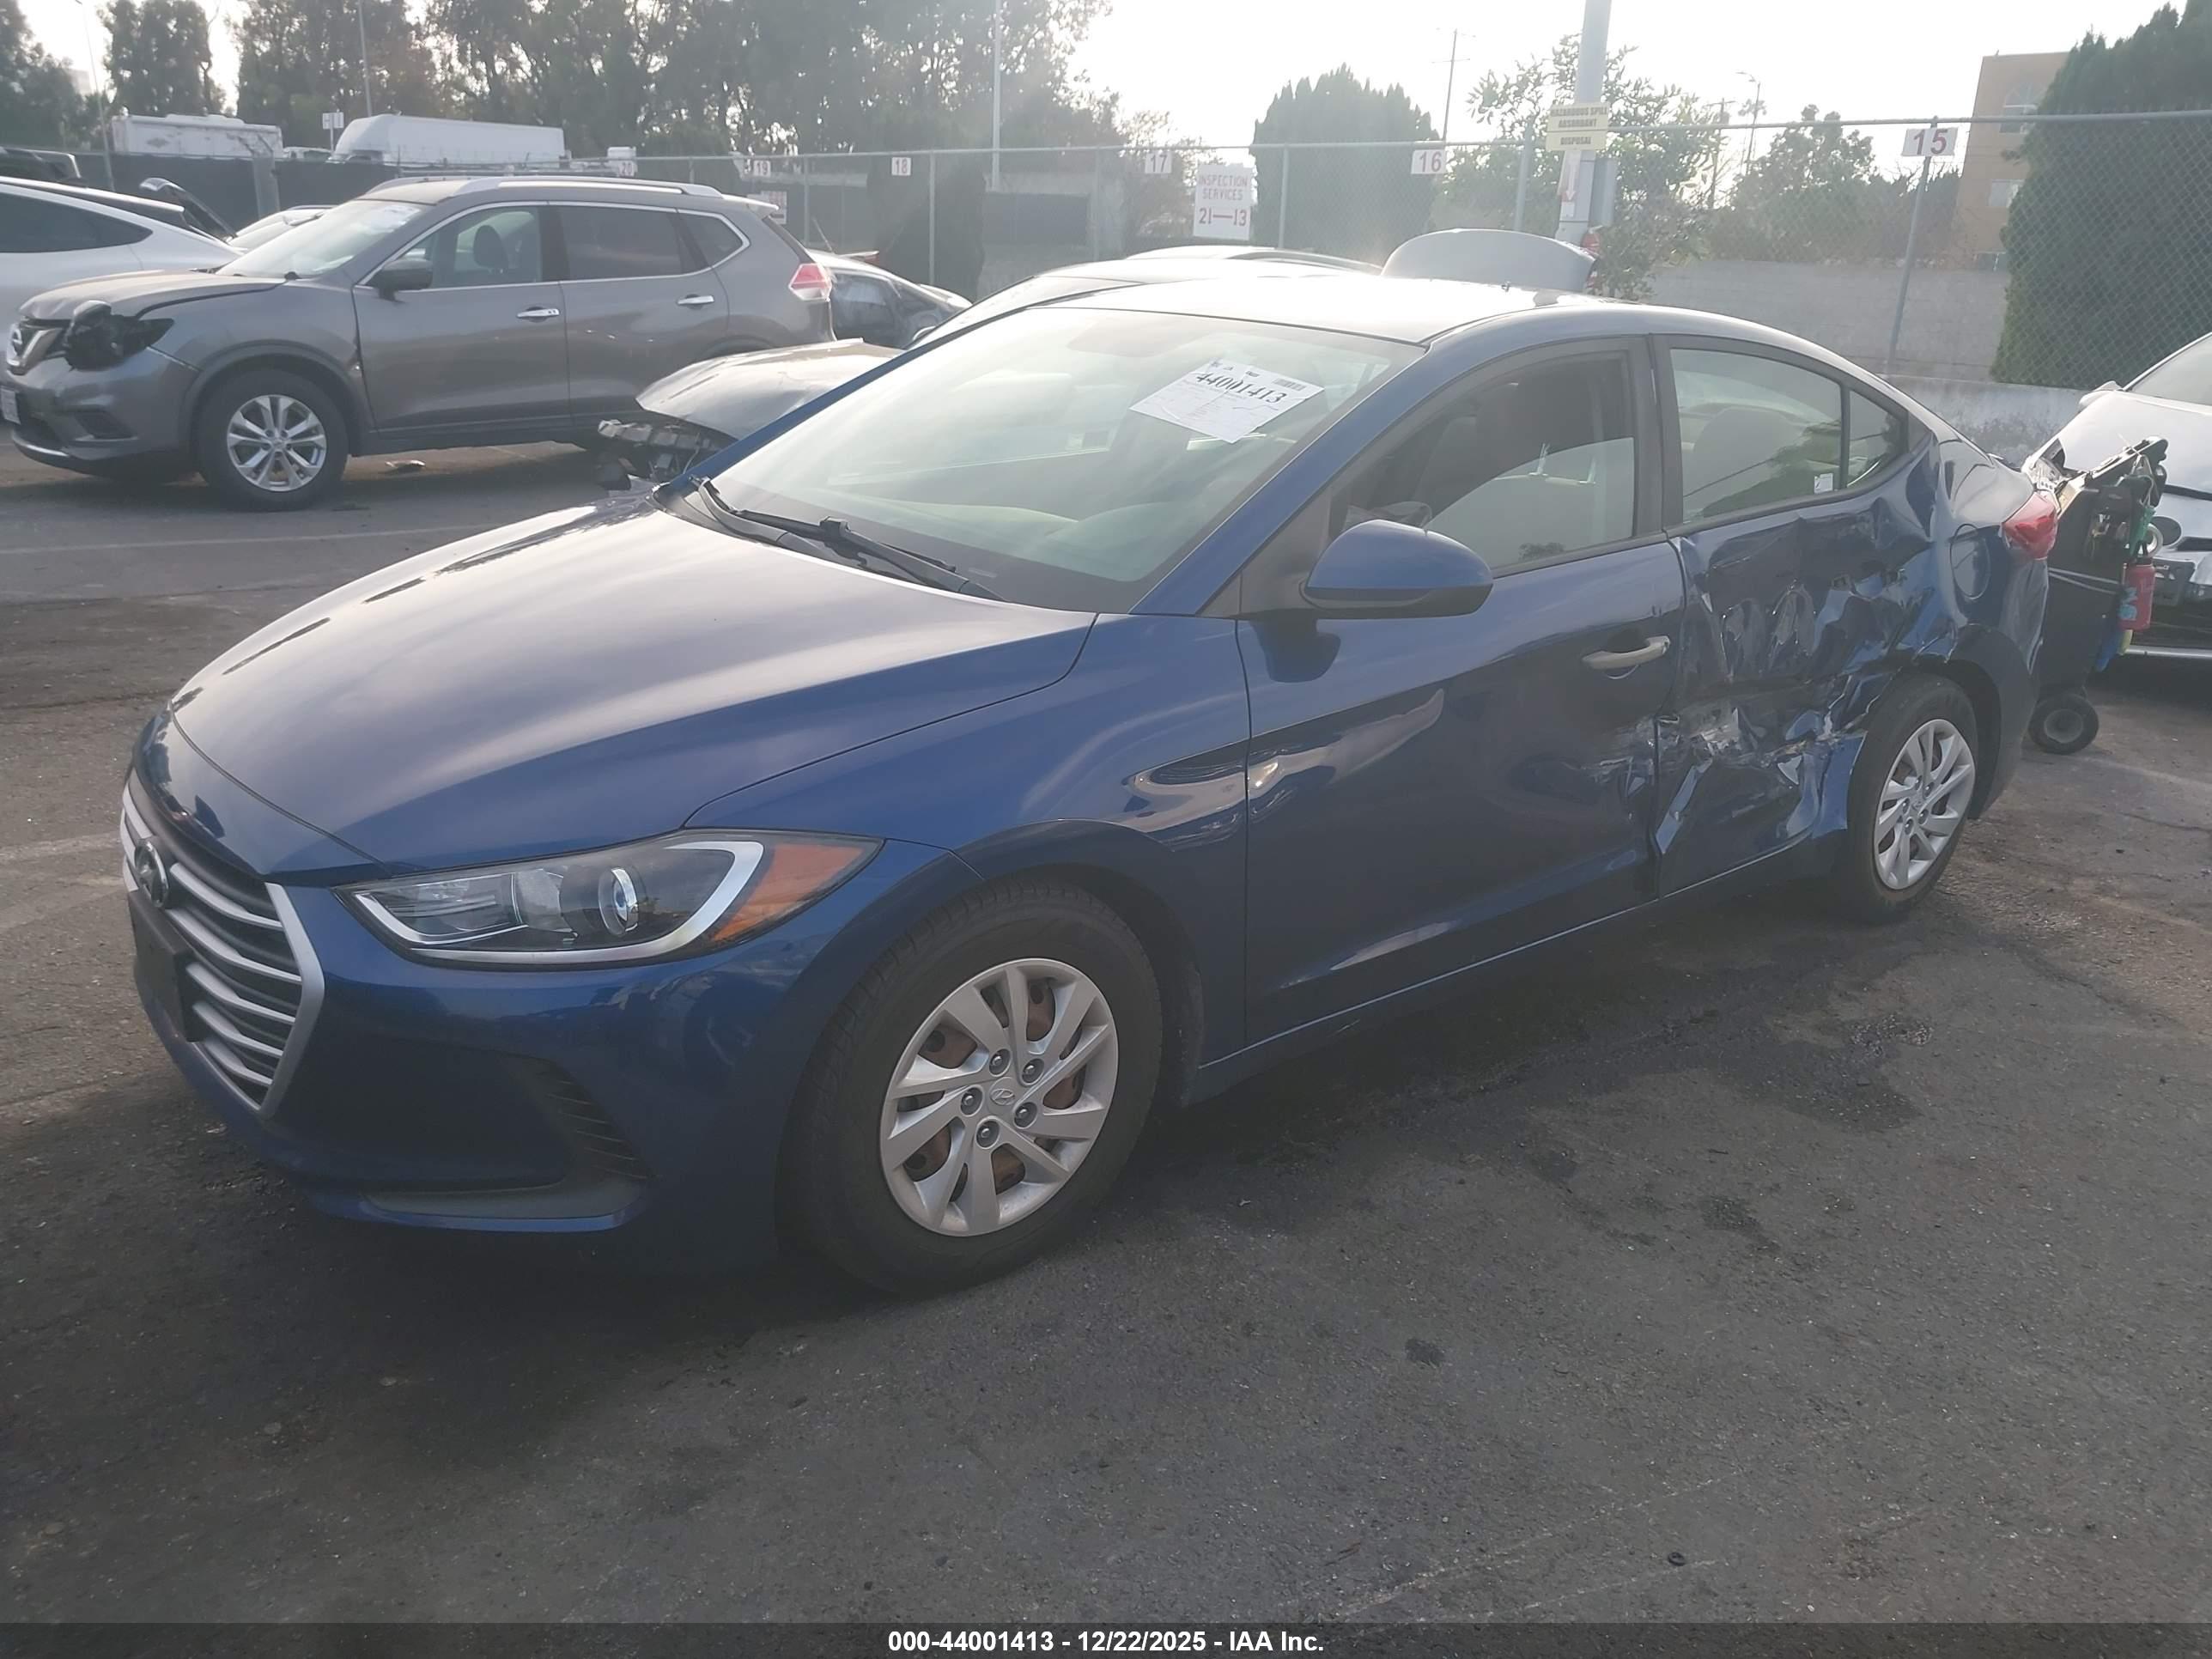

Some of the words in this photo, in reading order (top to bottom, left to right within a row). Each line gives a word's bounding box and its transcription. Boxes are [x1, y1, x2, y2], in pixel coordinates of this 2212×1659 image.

[1913, 128, 1948, 155] 15
[757, 161, 769, 176] 19
[896, 158, 908, 174] 18
[1151, 154, 1168, 173] 17
[1419, 150, 1442, 173] 16
[1198, 174, 1248, 187] INSPECTION
[1202, 188, 1243, 201] SERVICES
[1195, 372, 1287, 404] 44001413
